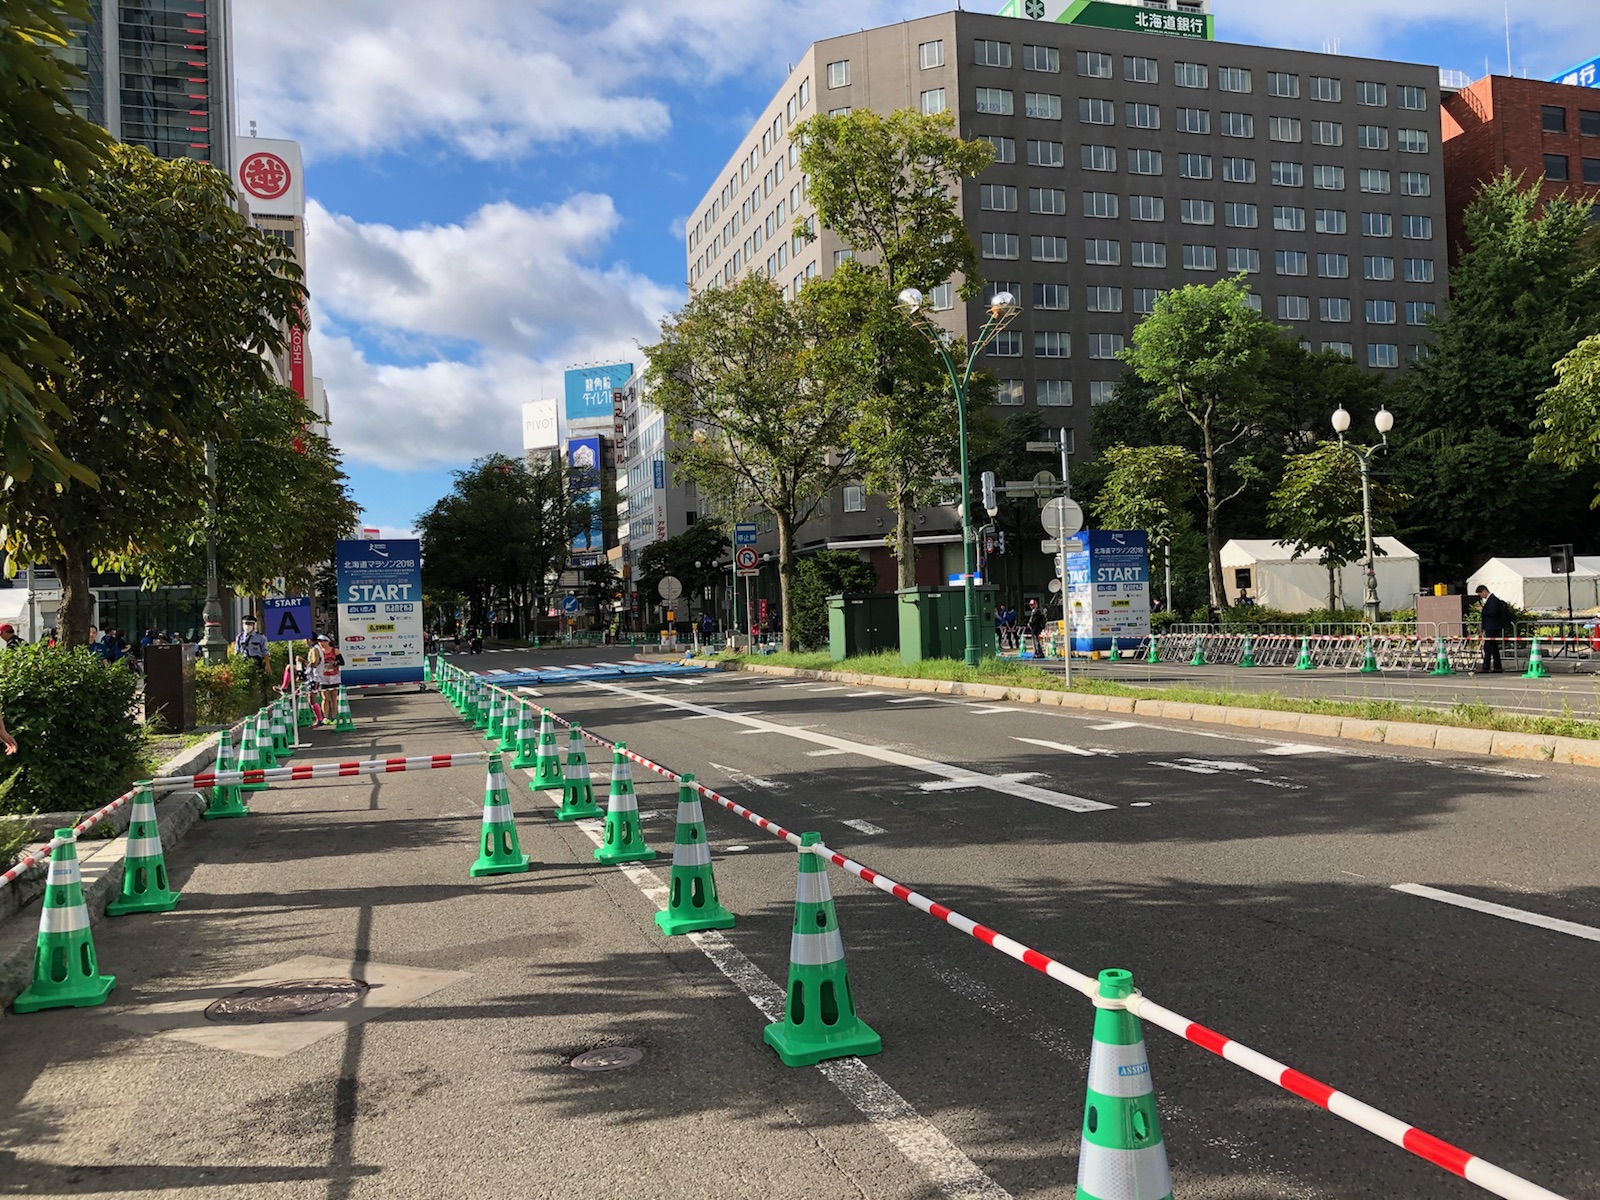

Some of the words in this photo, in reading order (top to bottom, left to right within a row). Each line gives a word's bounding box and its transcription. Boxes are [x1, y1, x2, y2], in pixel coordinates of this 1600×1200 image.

[1135, 12, 1204, 33] 北海道銀行
[526, 418, 554, 431] PIVOT
[614, 392, 624, 464] 日之出ビル
[344, 560, 415, 569] 北海道マラソン2018
[1097, 567, 1142, 581] START
[348, 584, 412, 601] START
[275, 598, 302, 608] START
[277, 611, 301, 635] A
